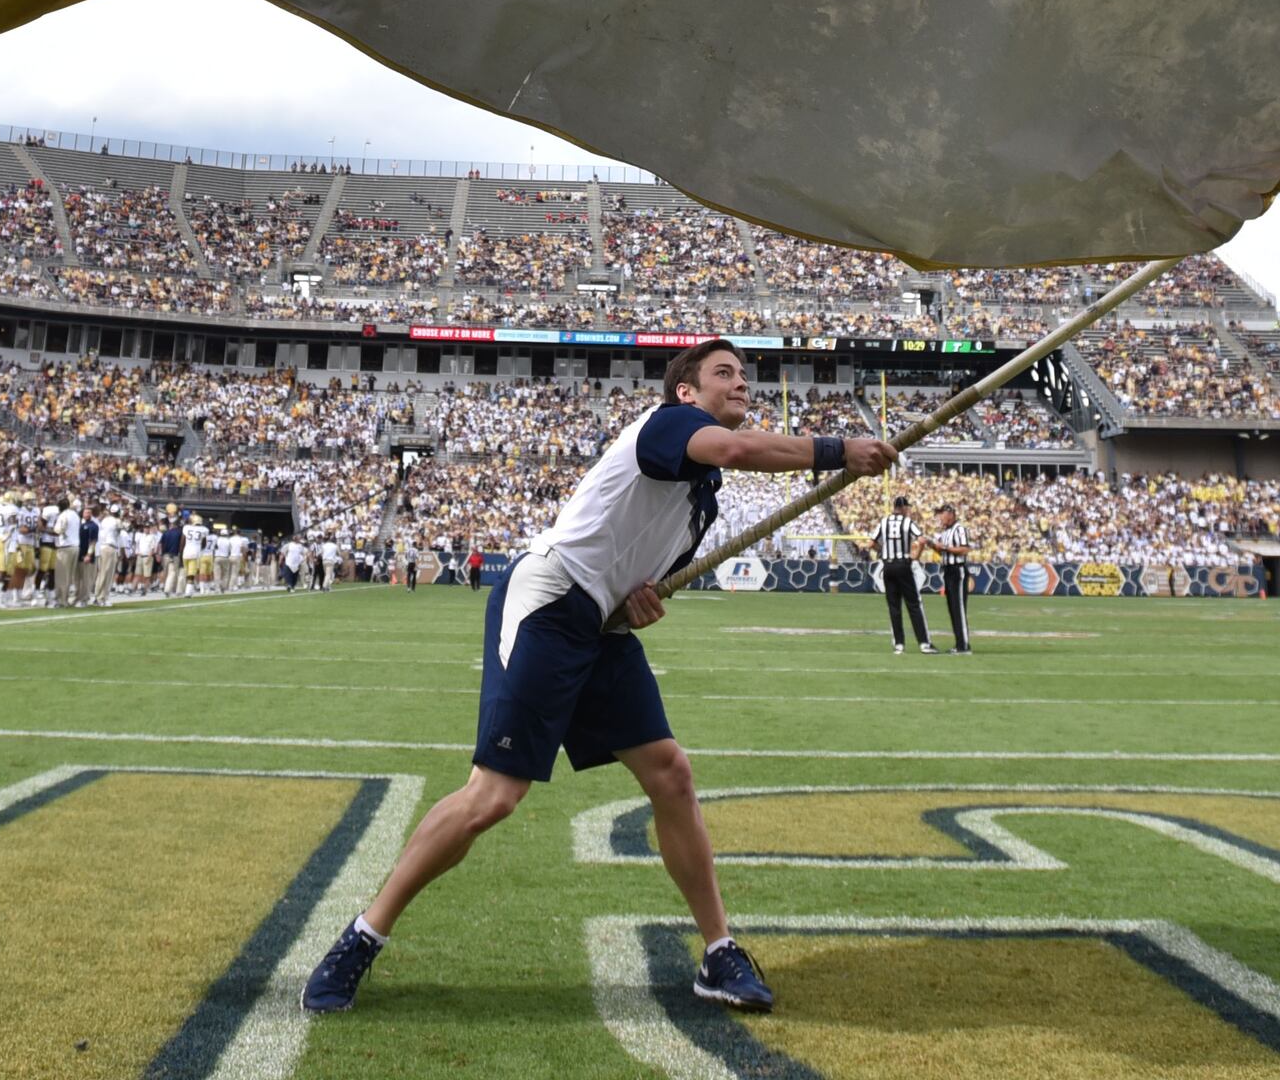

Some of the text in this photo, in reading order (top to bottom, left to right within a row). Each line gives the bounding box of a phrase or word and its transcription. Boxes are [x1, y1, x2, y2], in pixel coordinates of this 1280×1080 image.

[412, 327, 439, 338] CHOOSE
[440, 328, 454, 339] ANY
[461, 329, 470, 339] OR
[472, 329, 491, 340] MORE
[576, 333, 620, 343] DOMINOS.COM
[638, 334, 663, 344] CHOOSE
[665, 335, 678, 344] ANY
[686, 336, 695, 345] OR
[792, 338, 801, 347] 21
[903, 340, 926, 351] 10:29
[975, 340, 982, 351] 0
[187, 530, 203, 541] 53
